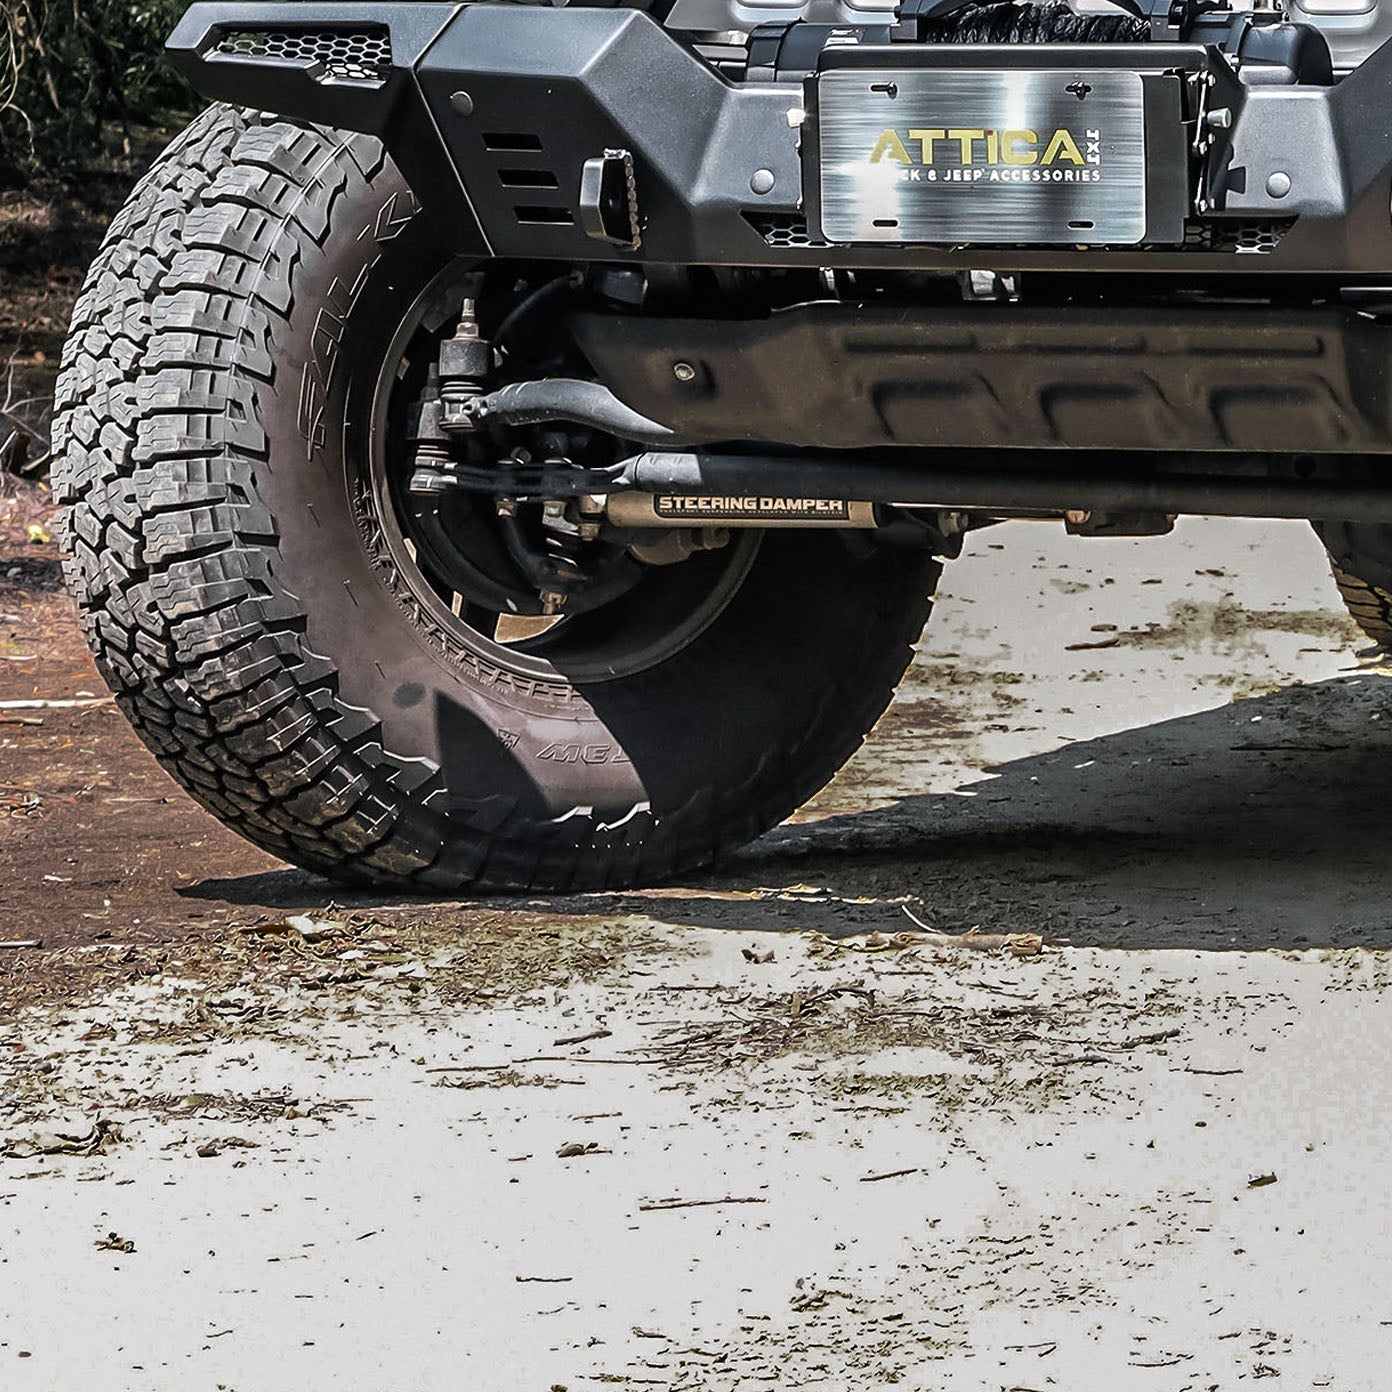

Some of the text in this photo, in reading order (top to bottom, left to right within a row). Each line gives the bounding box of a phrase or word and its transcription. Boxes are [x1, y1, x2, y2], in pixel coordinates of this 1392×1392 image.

[989, 170, 1101, 182] ACCESSORIES
[297, 191, 423, 461] FALK
[659, 496, 843, 511] STEERING DAMPER
